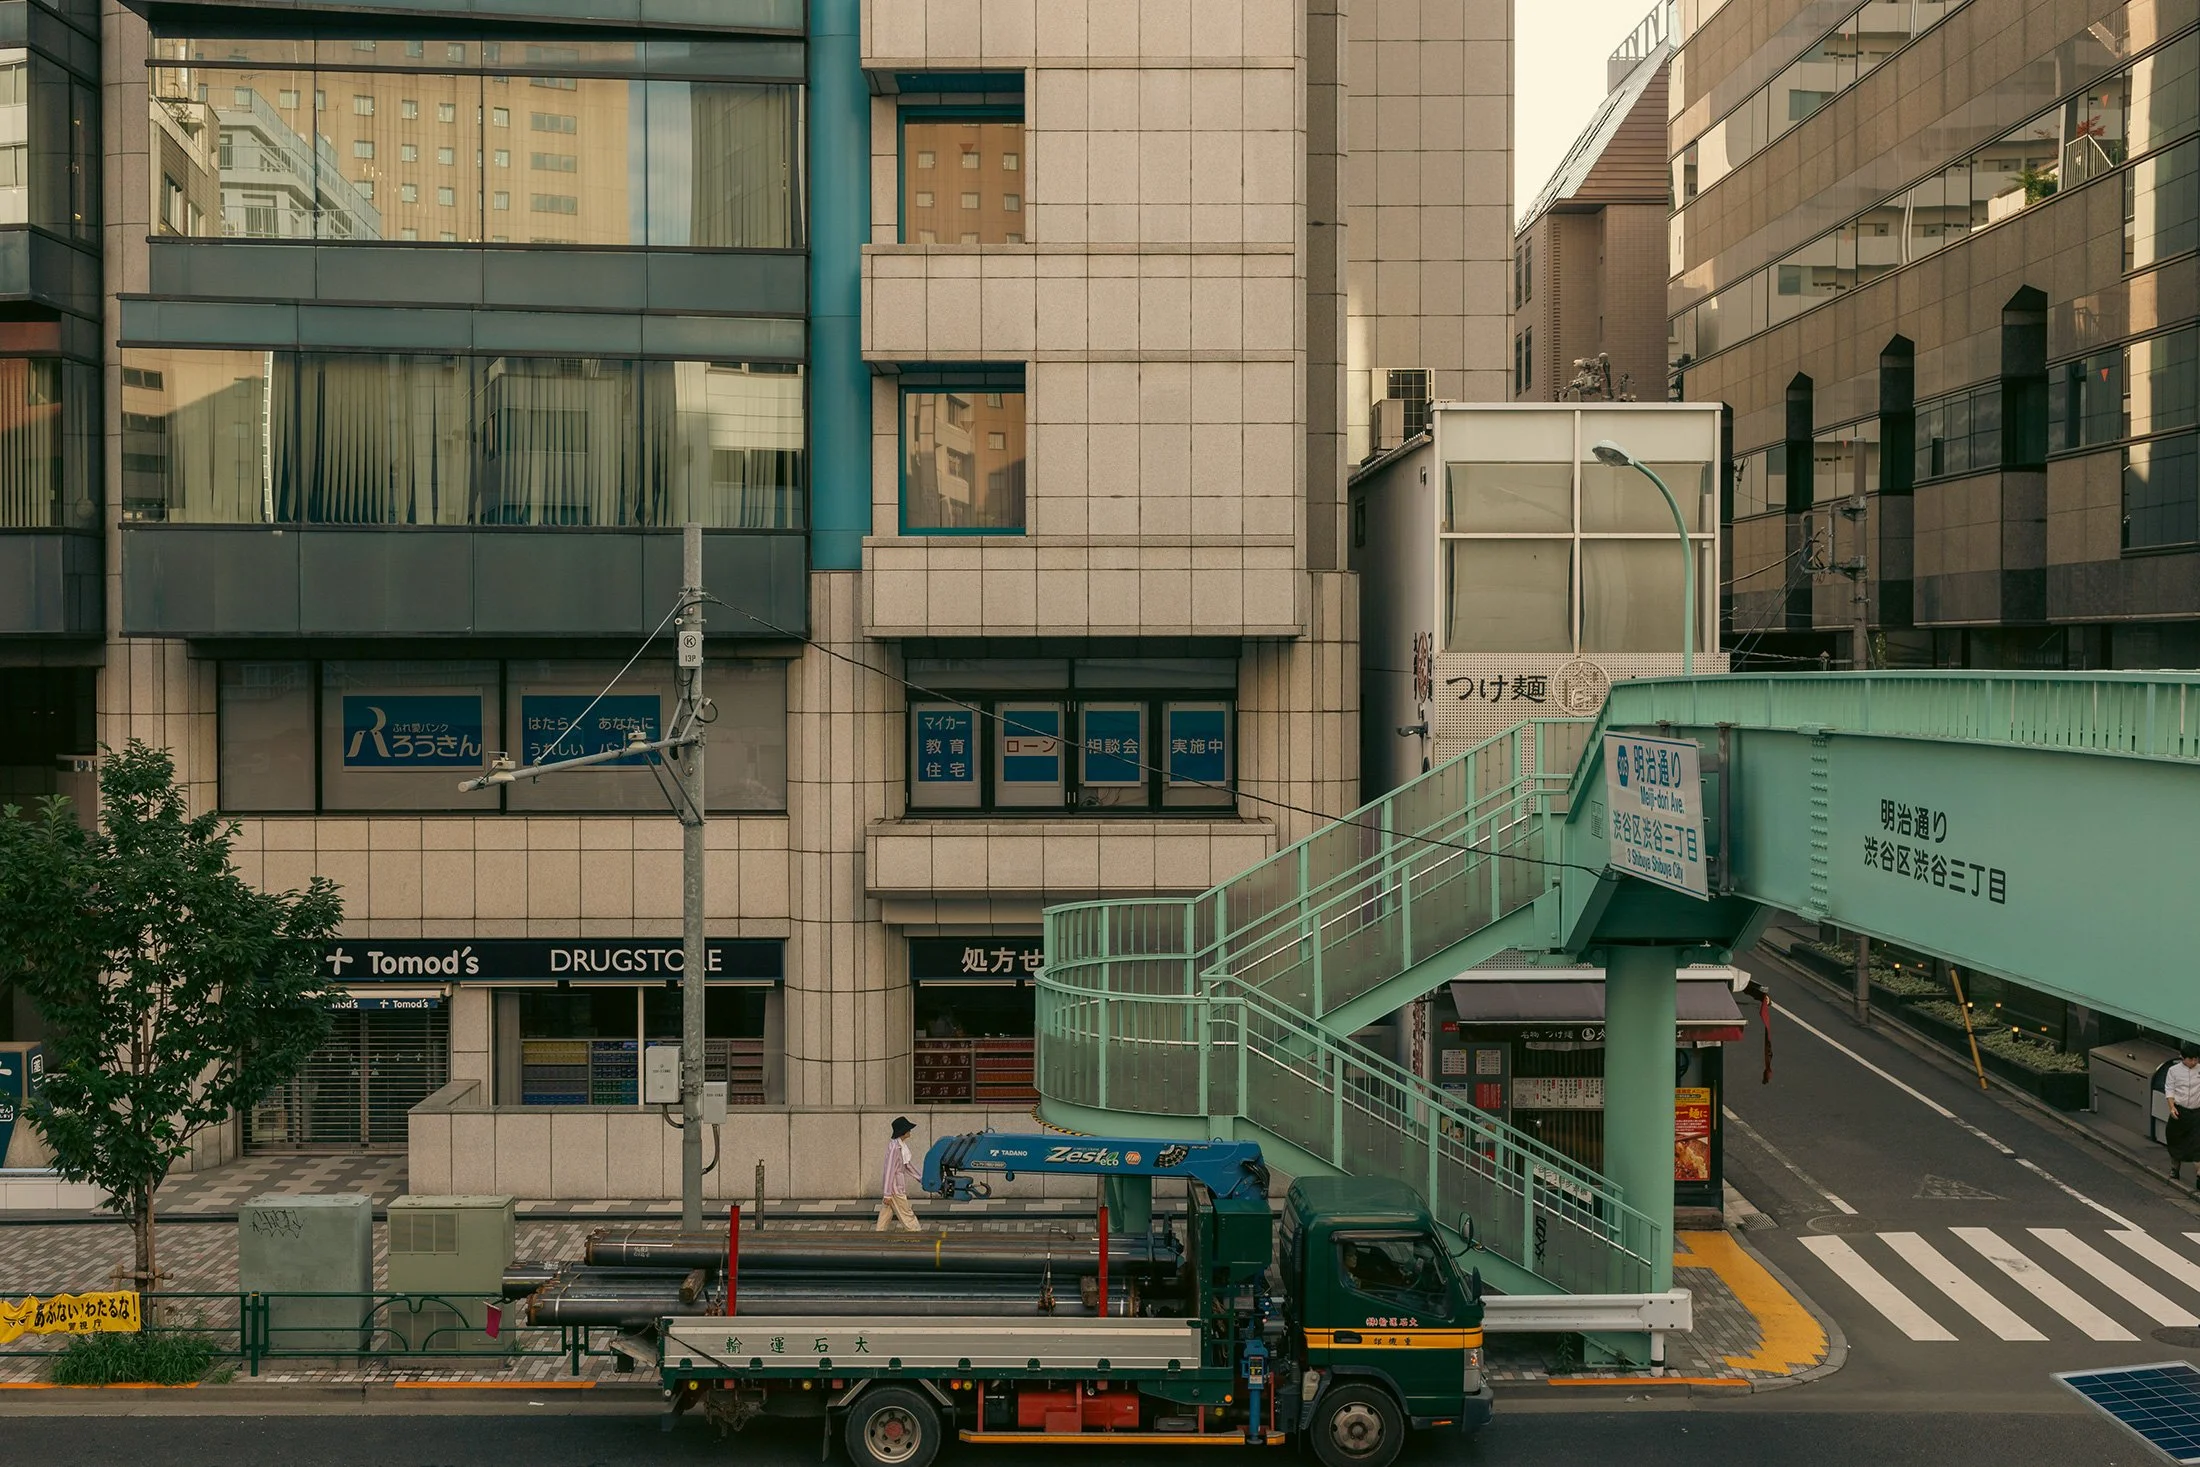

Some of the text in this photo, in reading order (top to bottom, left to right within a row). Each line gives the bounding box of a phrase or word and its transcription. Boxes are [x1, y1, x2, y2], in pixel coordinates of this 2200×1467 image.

[1446, 674, 1548, 704] つけ麺
[392, 722, 450, 733] ふれ愛バンク
[528, 716, 654, 731] はたらく あなたに
[924, 715, 966, 730] マイカー
[392, 734, 481, 758] ろうきん
[530, 742, 584, 757] うれしい
[926, 738, 965, 754] 教育
[1007, 738, 1057, 753] ローン
[1088, 738, 1138, 754] 相談会
[1172, 738, 1223, 754] 実施中
[926, 762, 965, 778] 住宅
[1633, 745, 1681, 788] 明治通り
[1671, 792, 1685, 814] Ave.
[1881, 799, 1947, 843] 明治通り
[1613, 810, 1698, 863] 渋谷区渋谷三丁目
[1632, 850, 1651, 873] Shibuya
[1652, 855, 1672, 879] Shibuya
[1673, 861, 1684, 884] City
[1864, 835, 2006, 904] 渋谷区渋谷三丁目
[367, 946, 480, 975] Tomod's
[551, 949, 722, 972] DRUGSTOE
[961, 947, 1045, 973] 処方せ
[392, 999, 429, 1009] Tomod's
[1002, 1149, 1028, 1157] TADANO
[1045, 1147, 1108, 1163] Zest
[1100, 1158, 1119, 1166] eco
